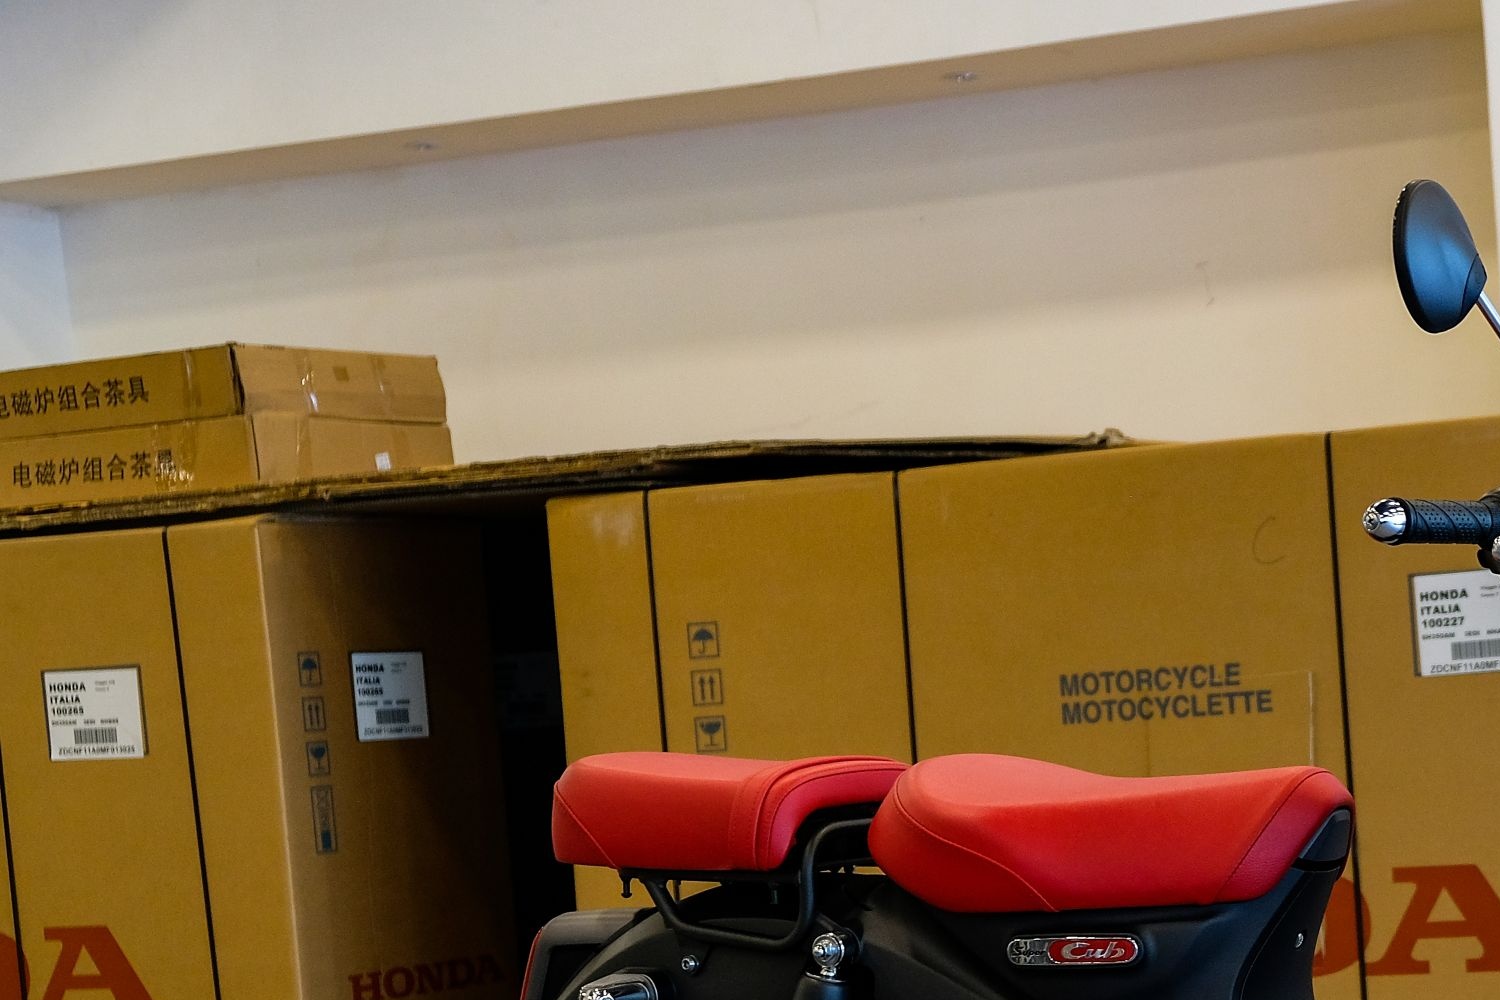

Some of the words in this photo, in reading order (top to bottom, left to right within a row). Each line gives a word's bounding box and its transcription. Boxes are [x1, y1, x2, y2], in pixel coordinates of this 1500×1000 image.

[1420, 588, 1468, 602] HONDA
[1421, 603, 1461, 616] ITALIA
[1422, 616, 1464, 629] 100227
[355, 663, 384, 674] HONDA
[356, 676, 380, 685] ITALIA
[1059, 662, 1241, 697] MOTORCYCLE
[49, 682, 86, 693] HONDA
[50, 695, 81, 705] ITALIA
[1061, 689, 1273, 725] MOTOCYCLETTE
[1062, 941, 1125, 960] Cub
